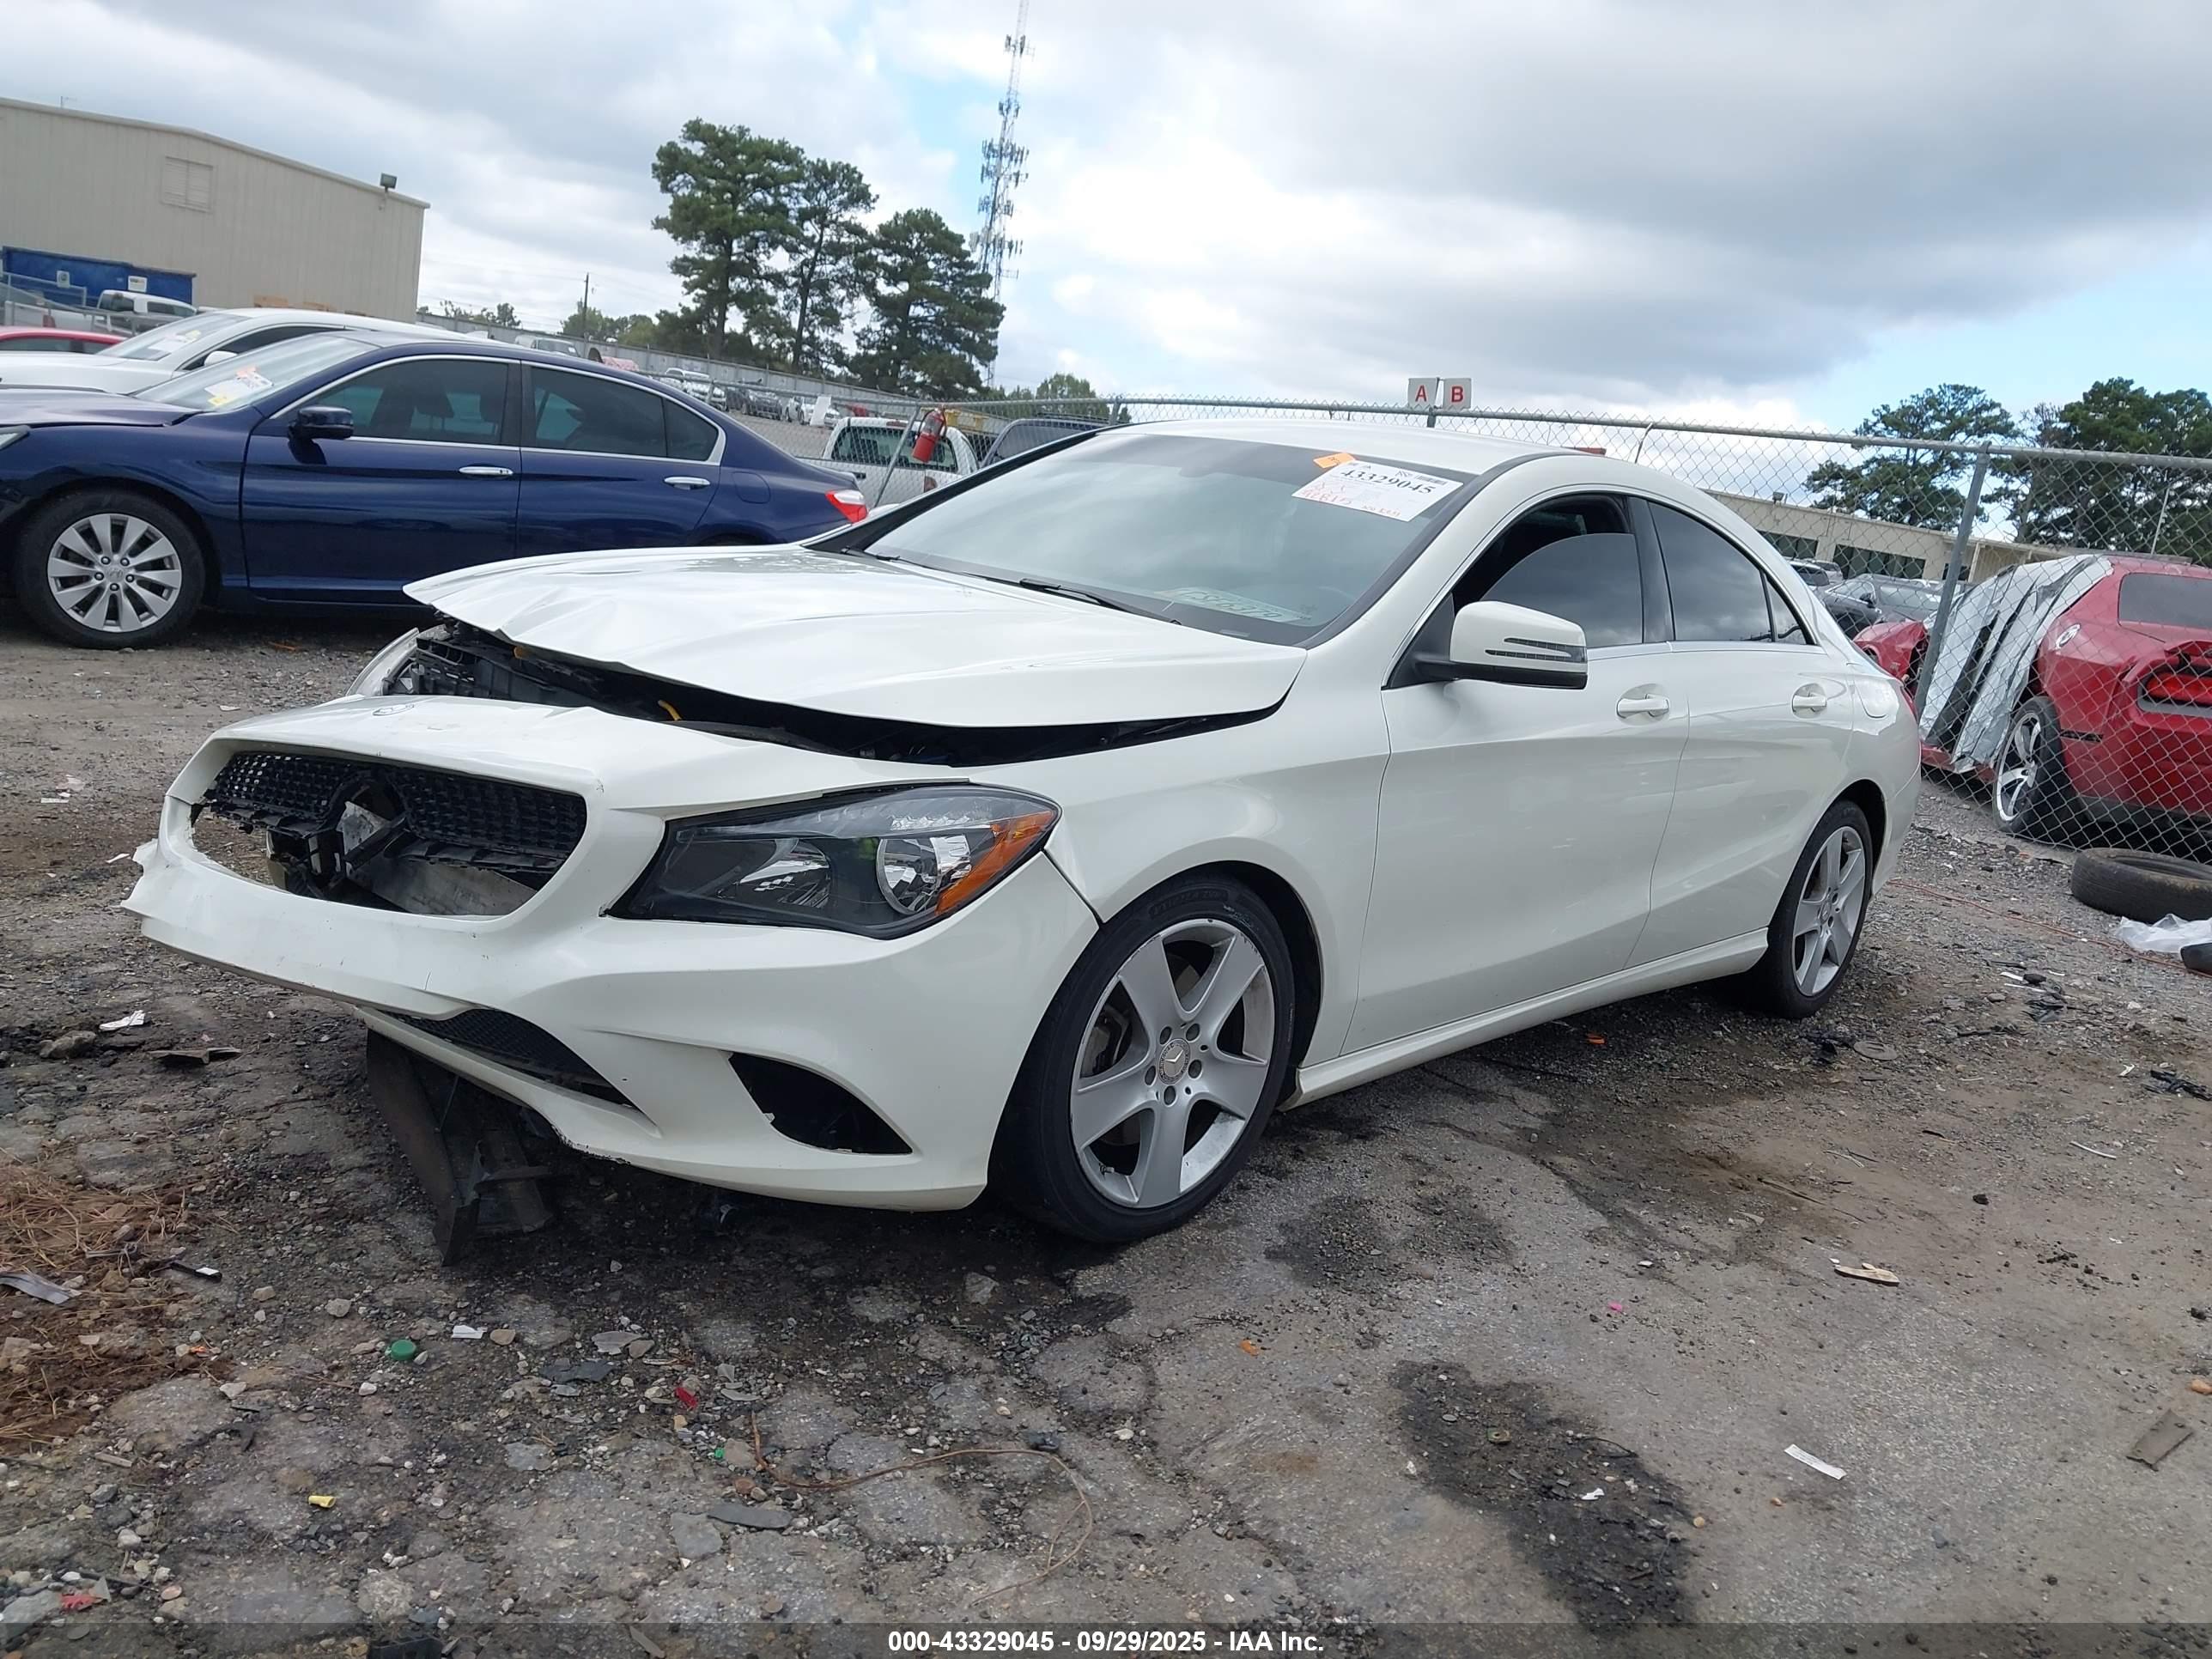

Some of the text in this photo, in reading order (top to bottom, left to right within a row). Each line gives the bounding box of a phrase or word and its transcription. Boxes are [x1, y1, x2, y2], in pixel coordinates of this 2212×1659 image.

[1415, 385, 1427, 403] A
[1450, 386, 1464, 403] B
[1340, 469, 1436, 494] 43329045
